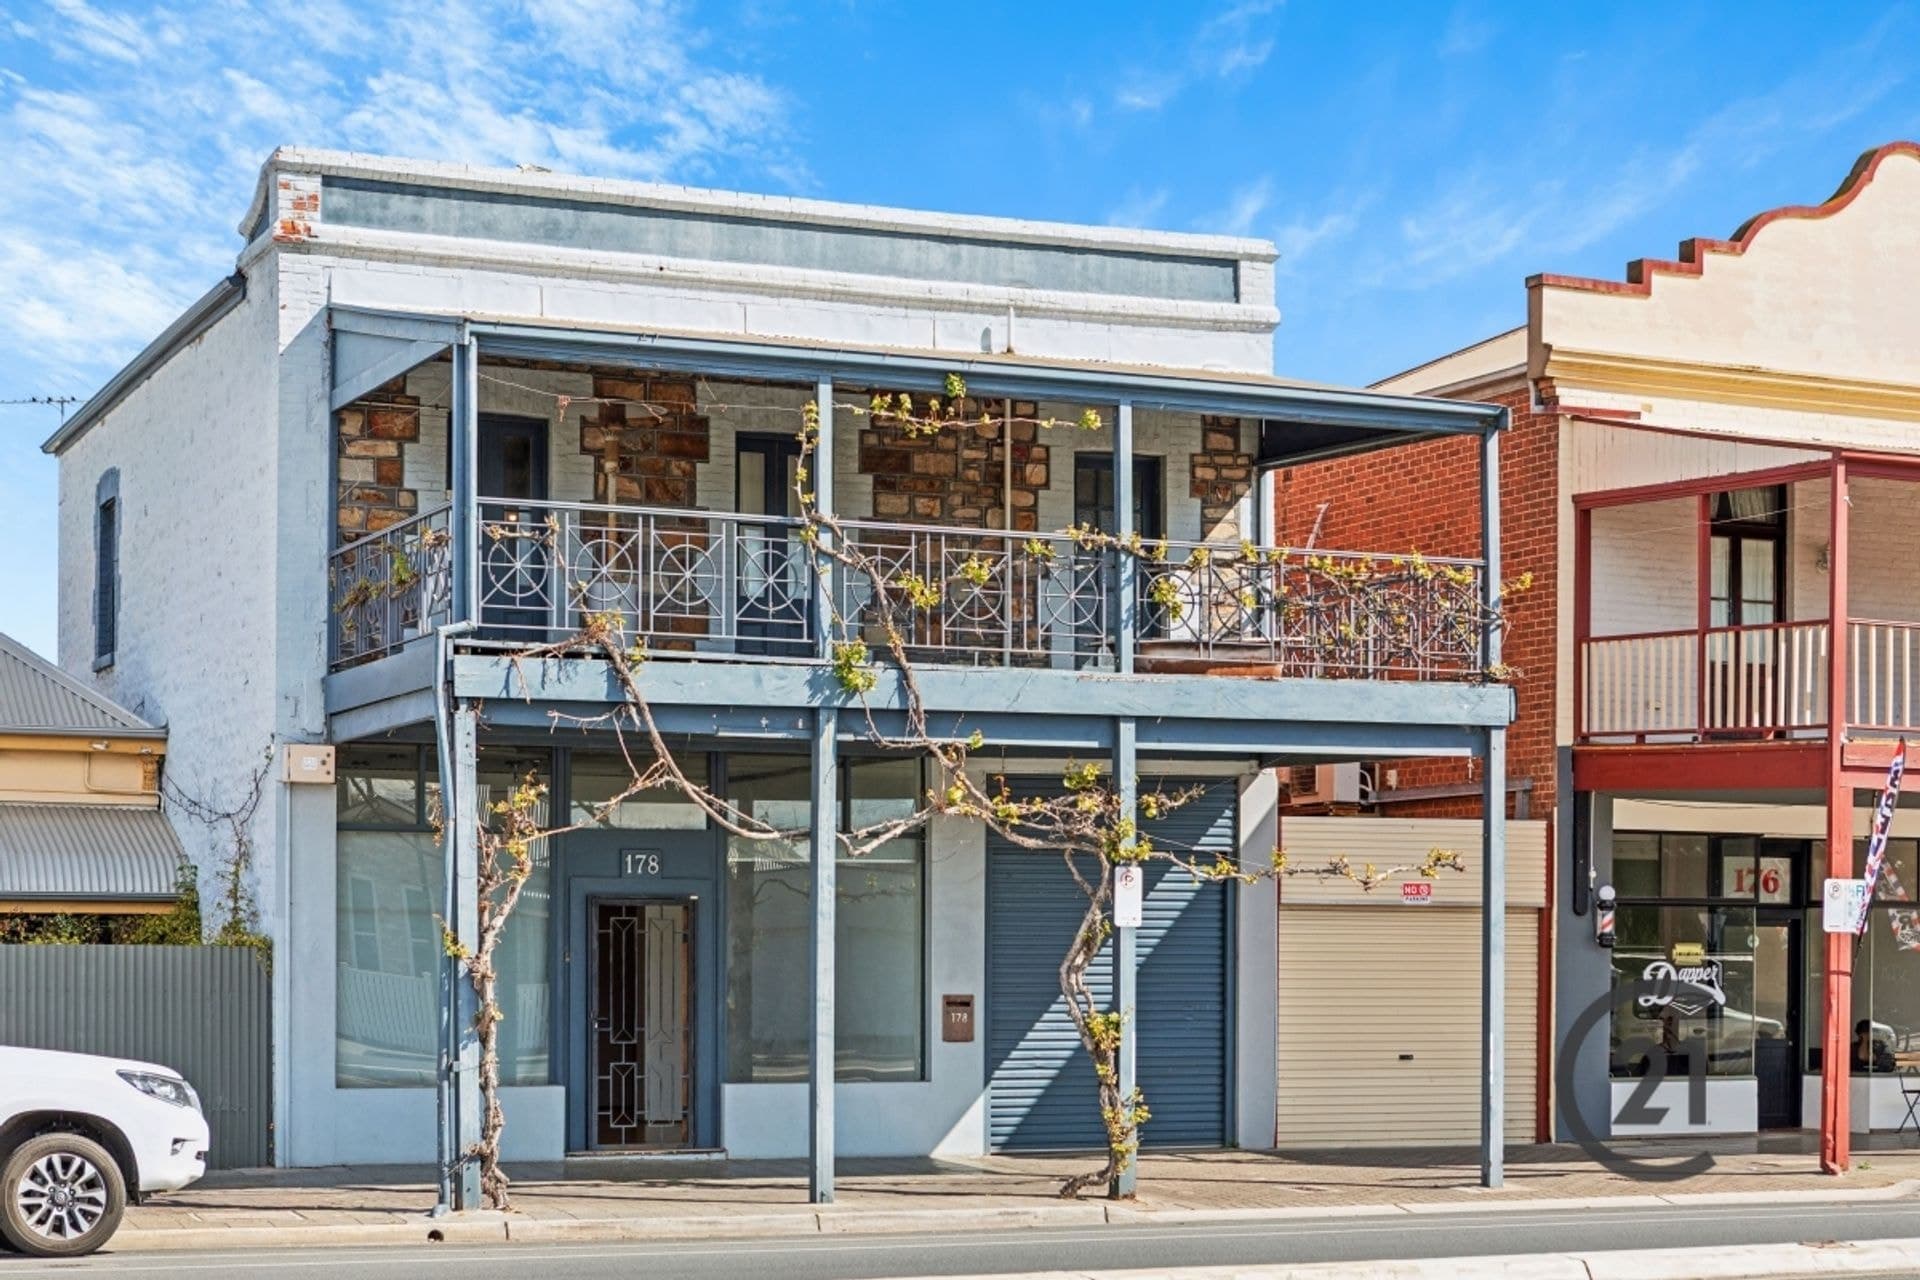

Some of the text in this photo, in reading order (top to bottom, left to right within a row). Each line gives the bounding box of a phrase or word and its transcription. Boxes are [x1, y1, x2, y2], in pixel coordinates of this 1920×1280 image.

[625, 854, 659, 874] 178
[1638, 961, 1725, 1006] Dapper
[951, 1012, 968, 1024] 178
